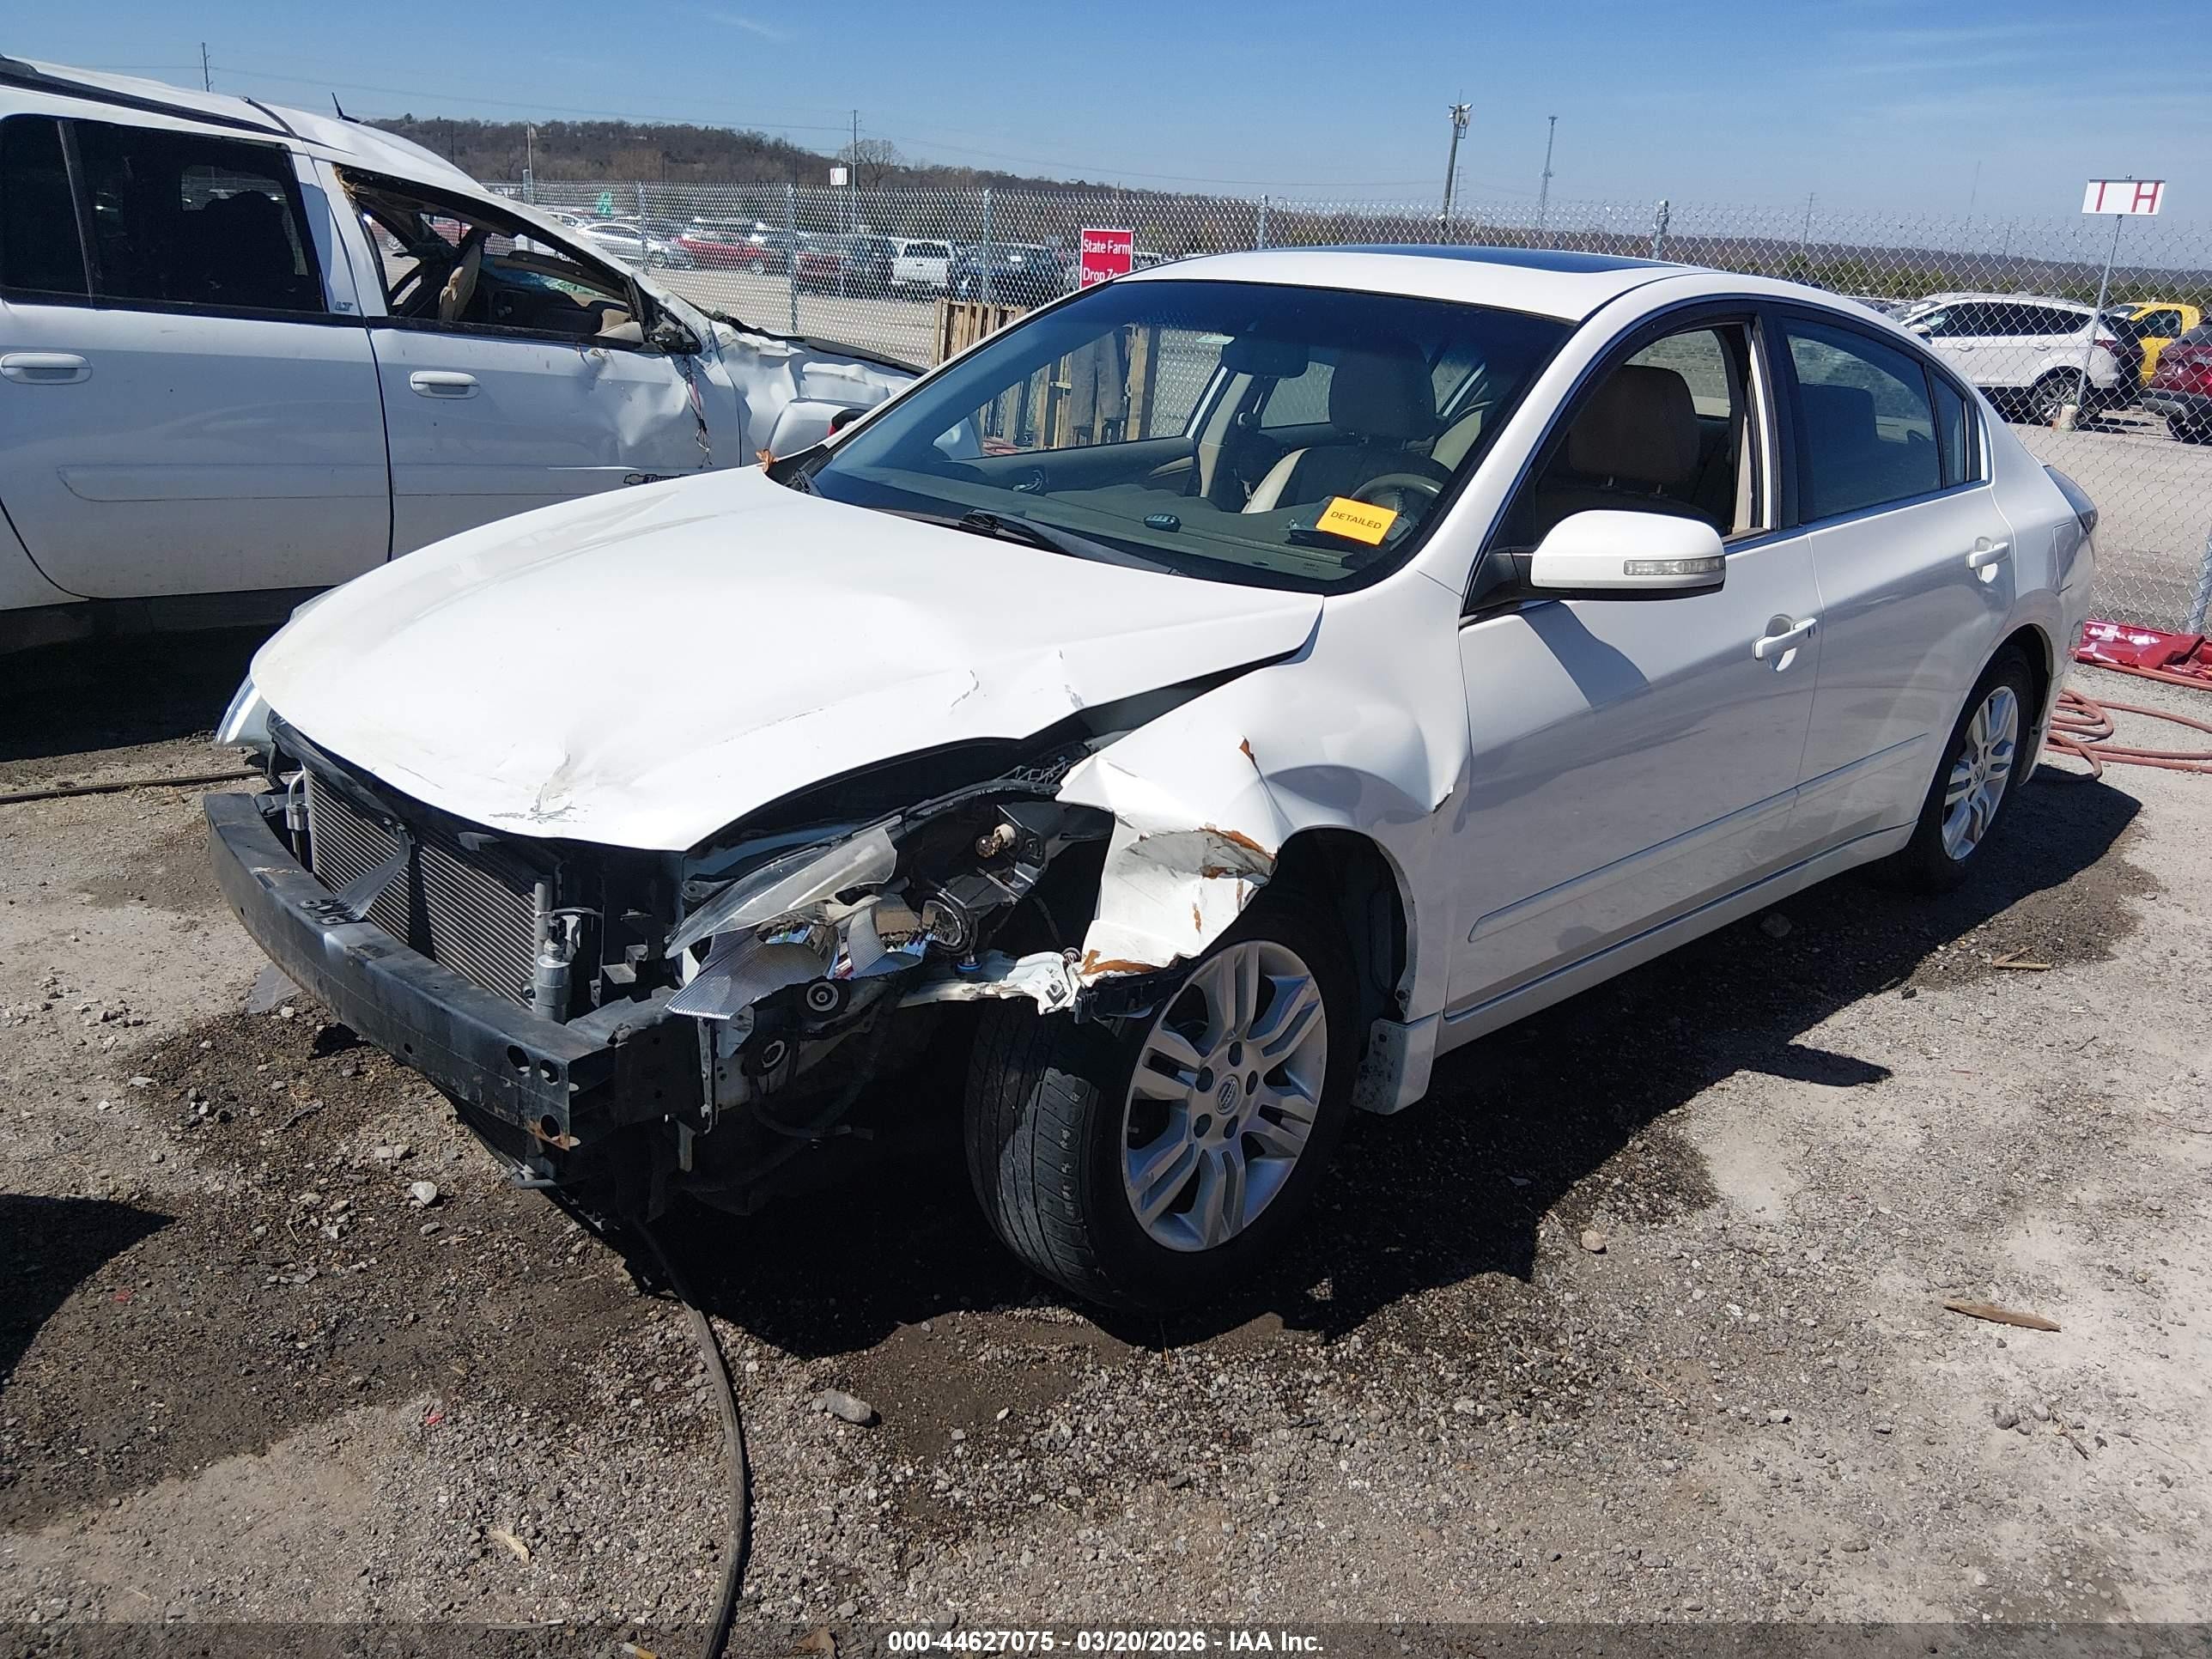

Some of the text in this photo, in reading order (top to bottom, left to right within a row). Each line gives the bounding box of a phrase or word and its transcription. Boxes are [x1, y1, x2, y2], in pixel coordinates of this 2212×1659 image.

[2131, 181, 2160, 213] H
[1083, 239, 1131, 255] State Farm
[1082, 267, 1106, 282] Drop
[336, 301, 354, 312] LT
[1330, 510, 1382, 530] DETAILED
